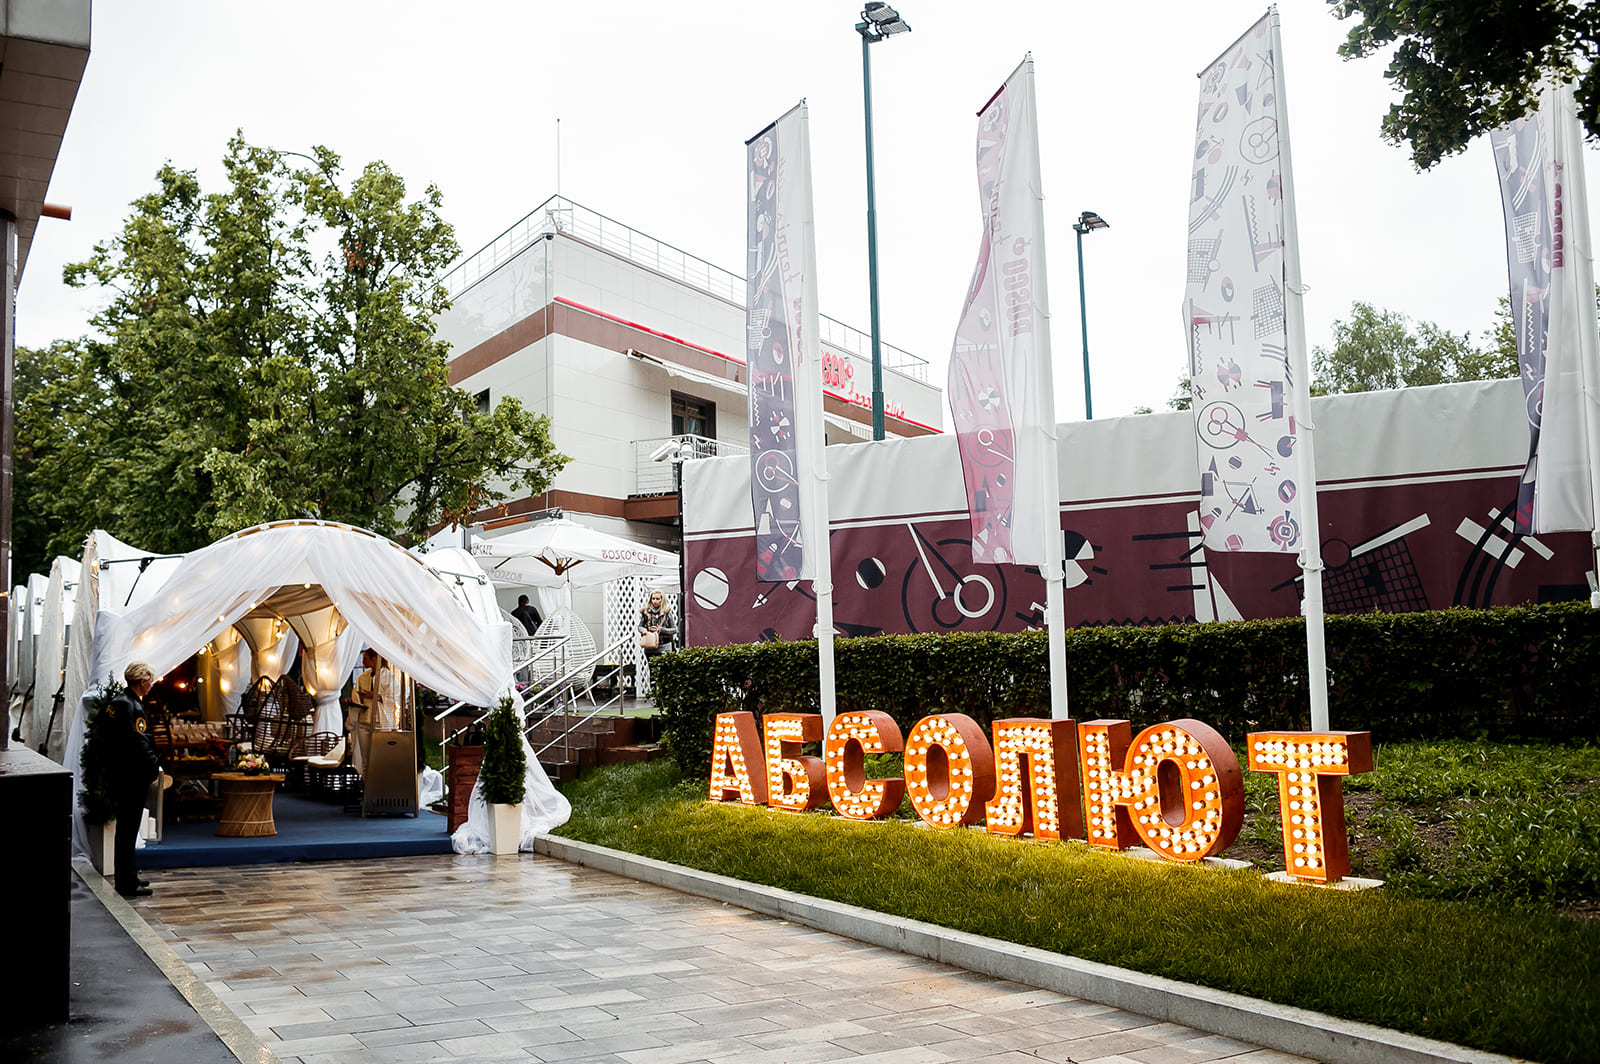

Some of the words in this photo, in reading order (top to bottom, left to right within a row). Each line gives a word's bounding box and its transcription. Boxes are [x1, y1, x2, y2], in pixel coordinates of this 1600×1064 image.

[602, 550, 632, 561] BOSCO
[637, 552, 657, 565] CAFE
[708, 710, 1371, 884] АБСОЛЮТ
